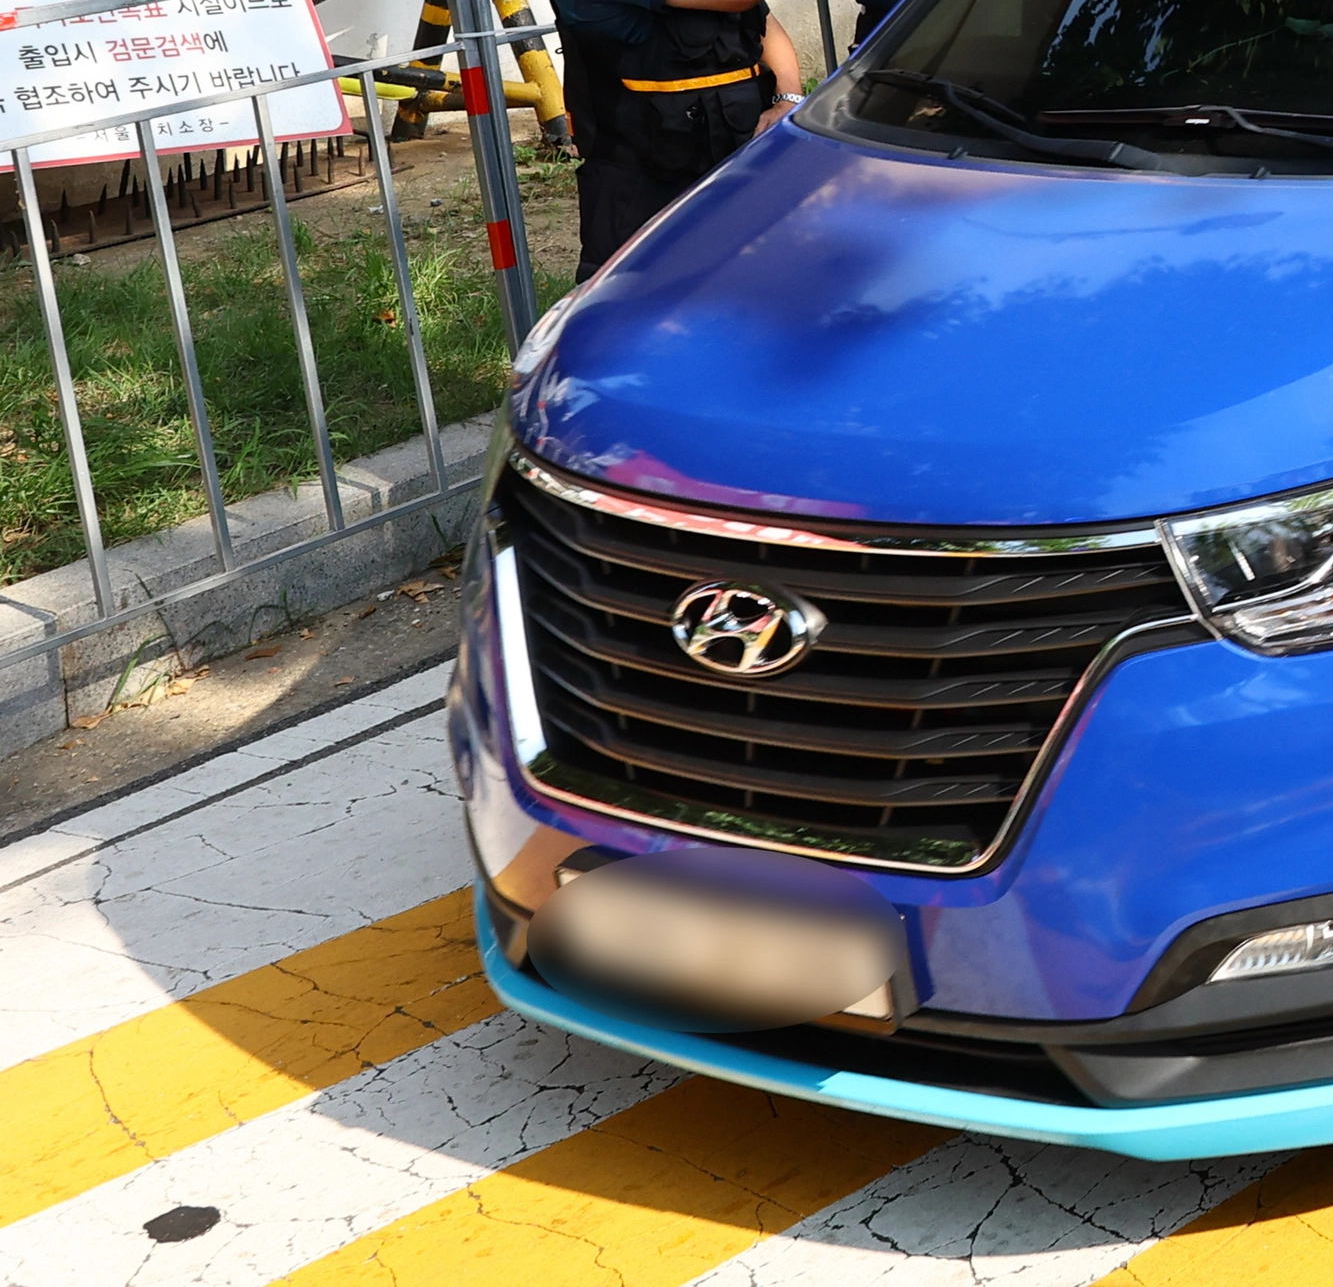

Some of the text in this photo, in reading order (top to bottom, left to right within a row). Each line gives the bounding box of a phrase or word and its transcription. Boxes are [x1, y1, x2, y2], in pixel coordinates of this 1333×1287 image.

[18, 30, 229, 70] 출입시 검문검색에
[14, 78, 121, 111] 협조하여
[128, 71, 202, 100] 주시기
[210, 62, 301, 89] 바랍니다
